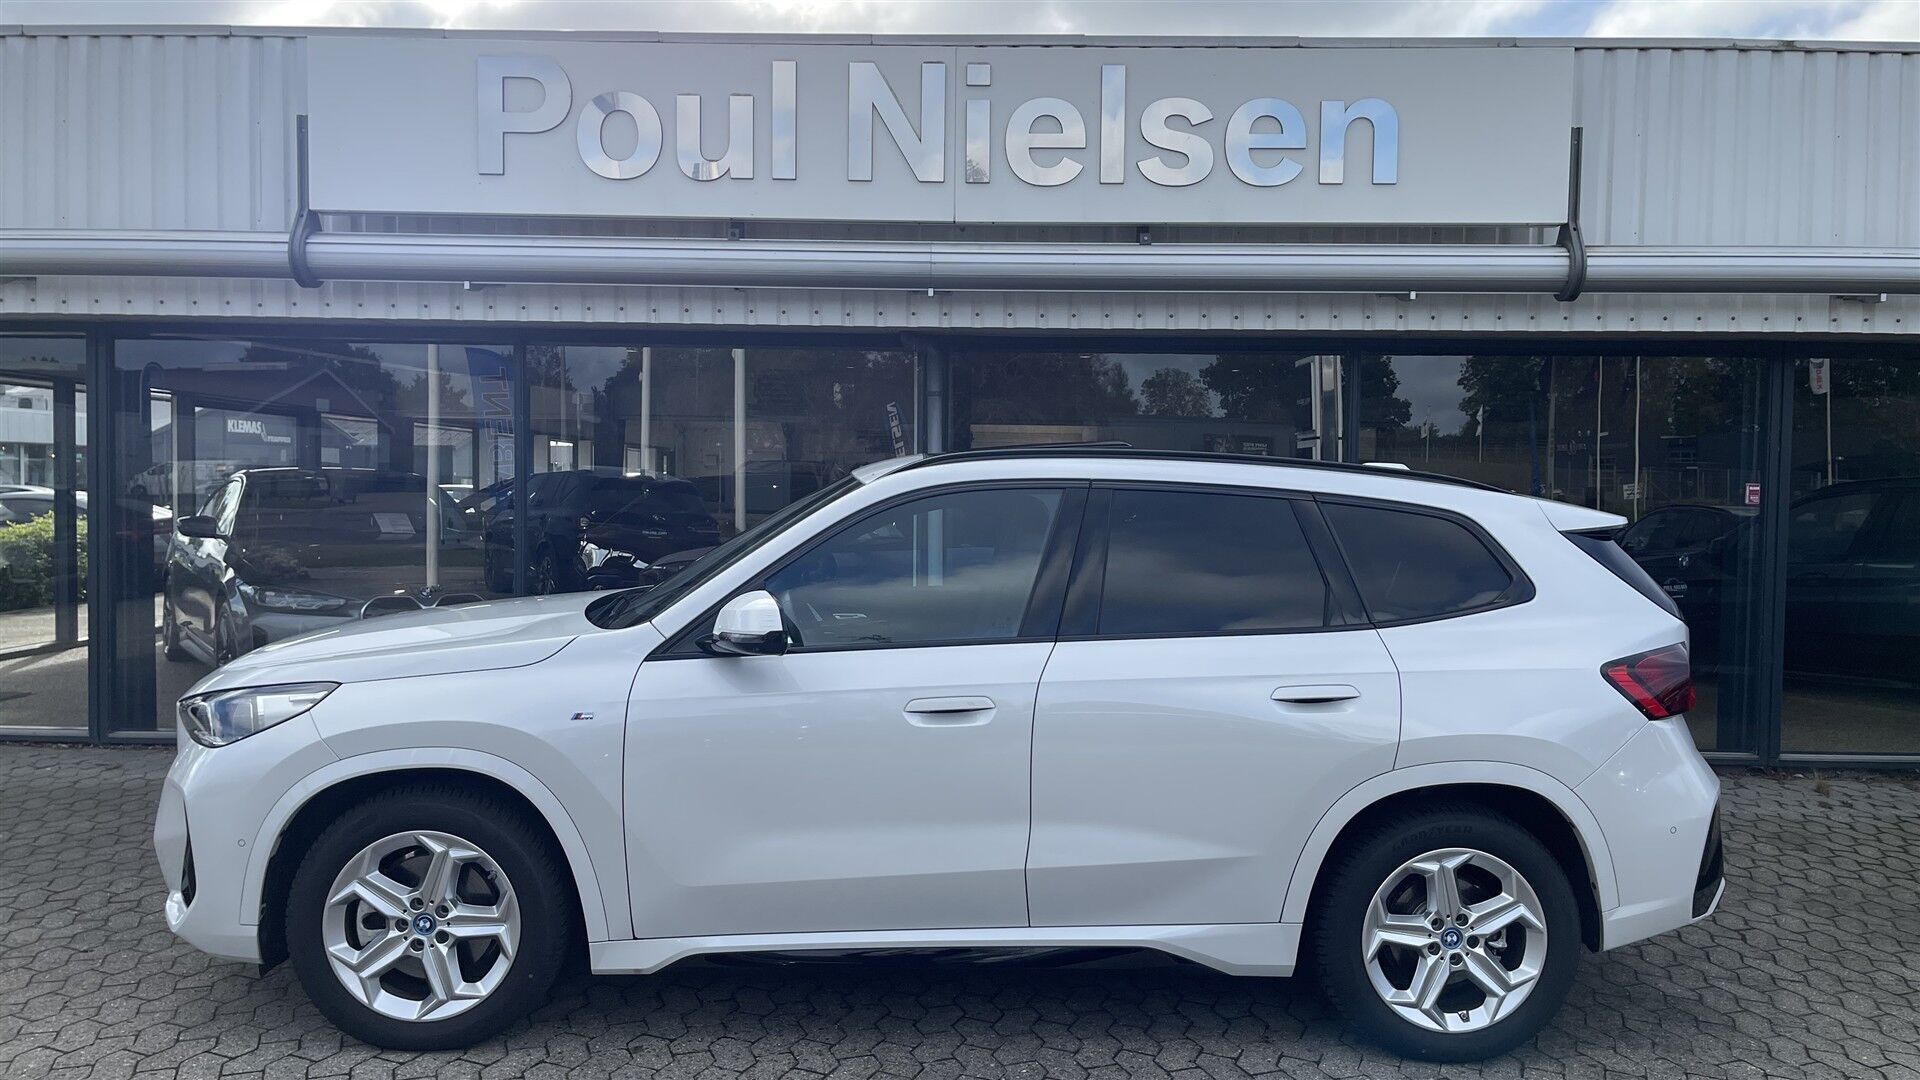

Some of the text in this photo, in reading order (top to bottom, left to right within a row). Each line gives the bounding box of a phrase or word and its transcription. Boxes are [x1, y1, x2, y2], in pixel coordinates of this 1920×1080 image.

[477, 55, 1398, 187] Poul Nielsen
[227, 418, 262, 434] KLEMAS
